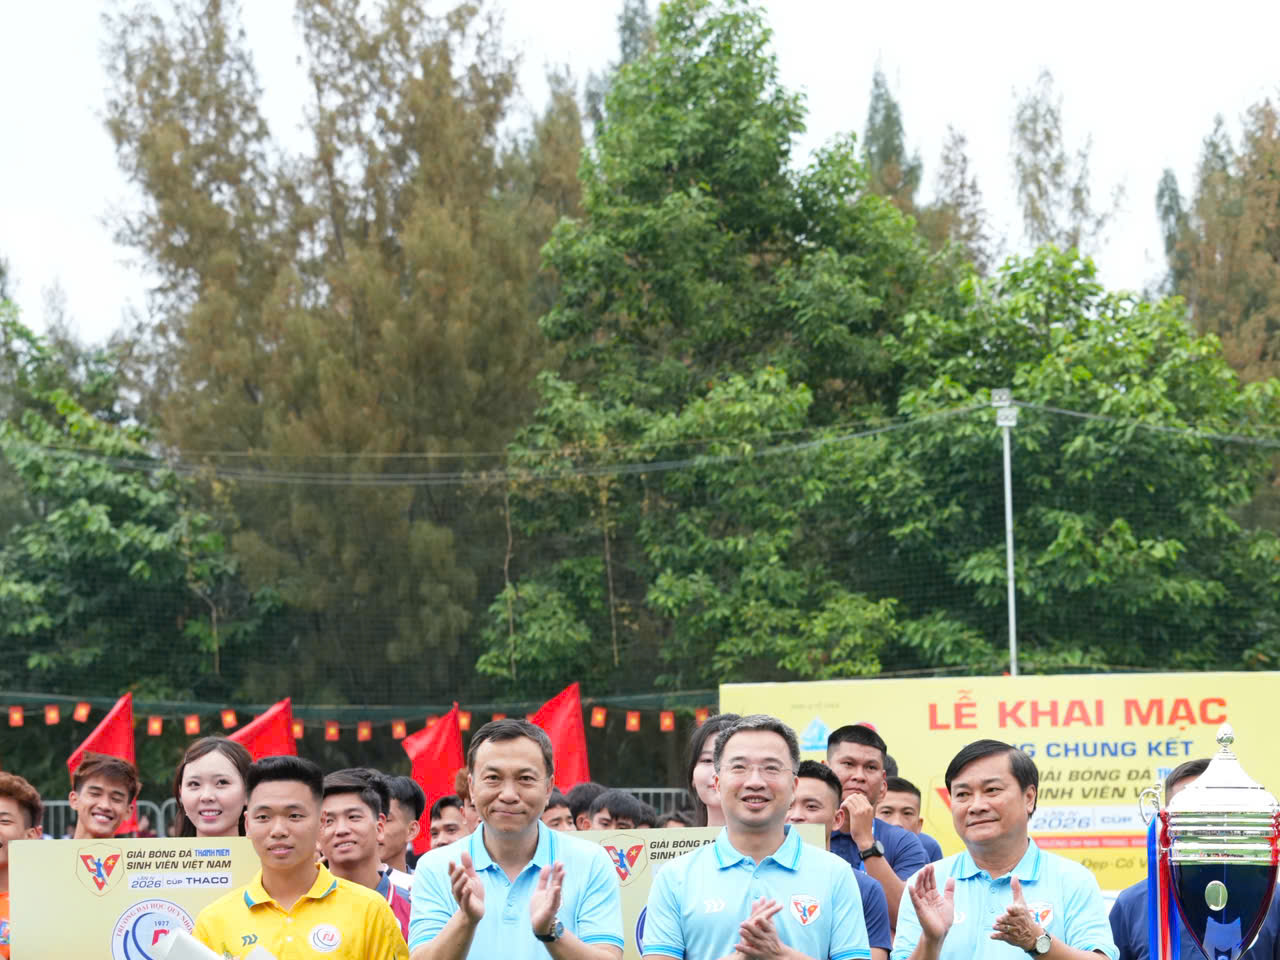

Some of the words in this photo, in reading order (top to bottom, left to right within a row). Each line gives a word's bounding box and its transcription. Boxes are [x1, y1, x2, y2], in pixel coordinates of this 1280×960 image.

[929, 689, 977, 730] LỄ
[999, 699, 1104, 728] KHAI
[1124, 697, 1228, 730] MẠC
[1046, 741, 1137, 758] CHUNG
[1148, 737, 1194, 756] KẾT
[1039, 766, 1062, 782] IẢI
[1040, 787, 1074, 799] INH
[1081, 784, 1127, 799] VIÊN
[672, 838, 700, 849] BÓNG
[127, 849, 146, 859] GIẢI
[148, 848, 176, 858] BÓNG
[178, 848, 192, 858] ĐÁ
[650, 852, 675, 860] SINH
[127, 861, 151, 870] SINH
[155, 859, 179, 869] VIÊN
[182, 859, 204, 870] VIỆT
[206, 860, 232, 869] NAM
[131, 880, 162, 889] 2026
[166, 878, 183, 886] CÚP
[185, 876, 229, 885] THACO
